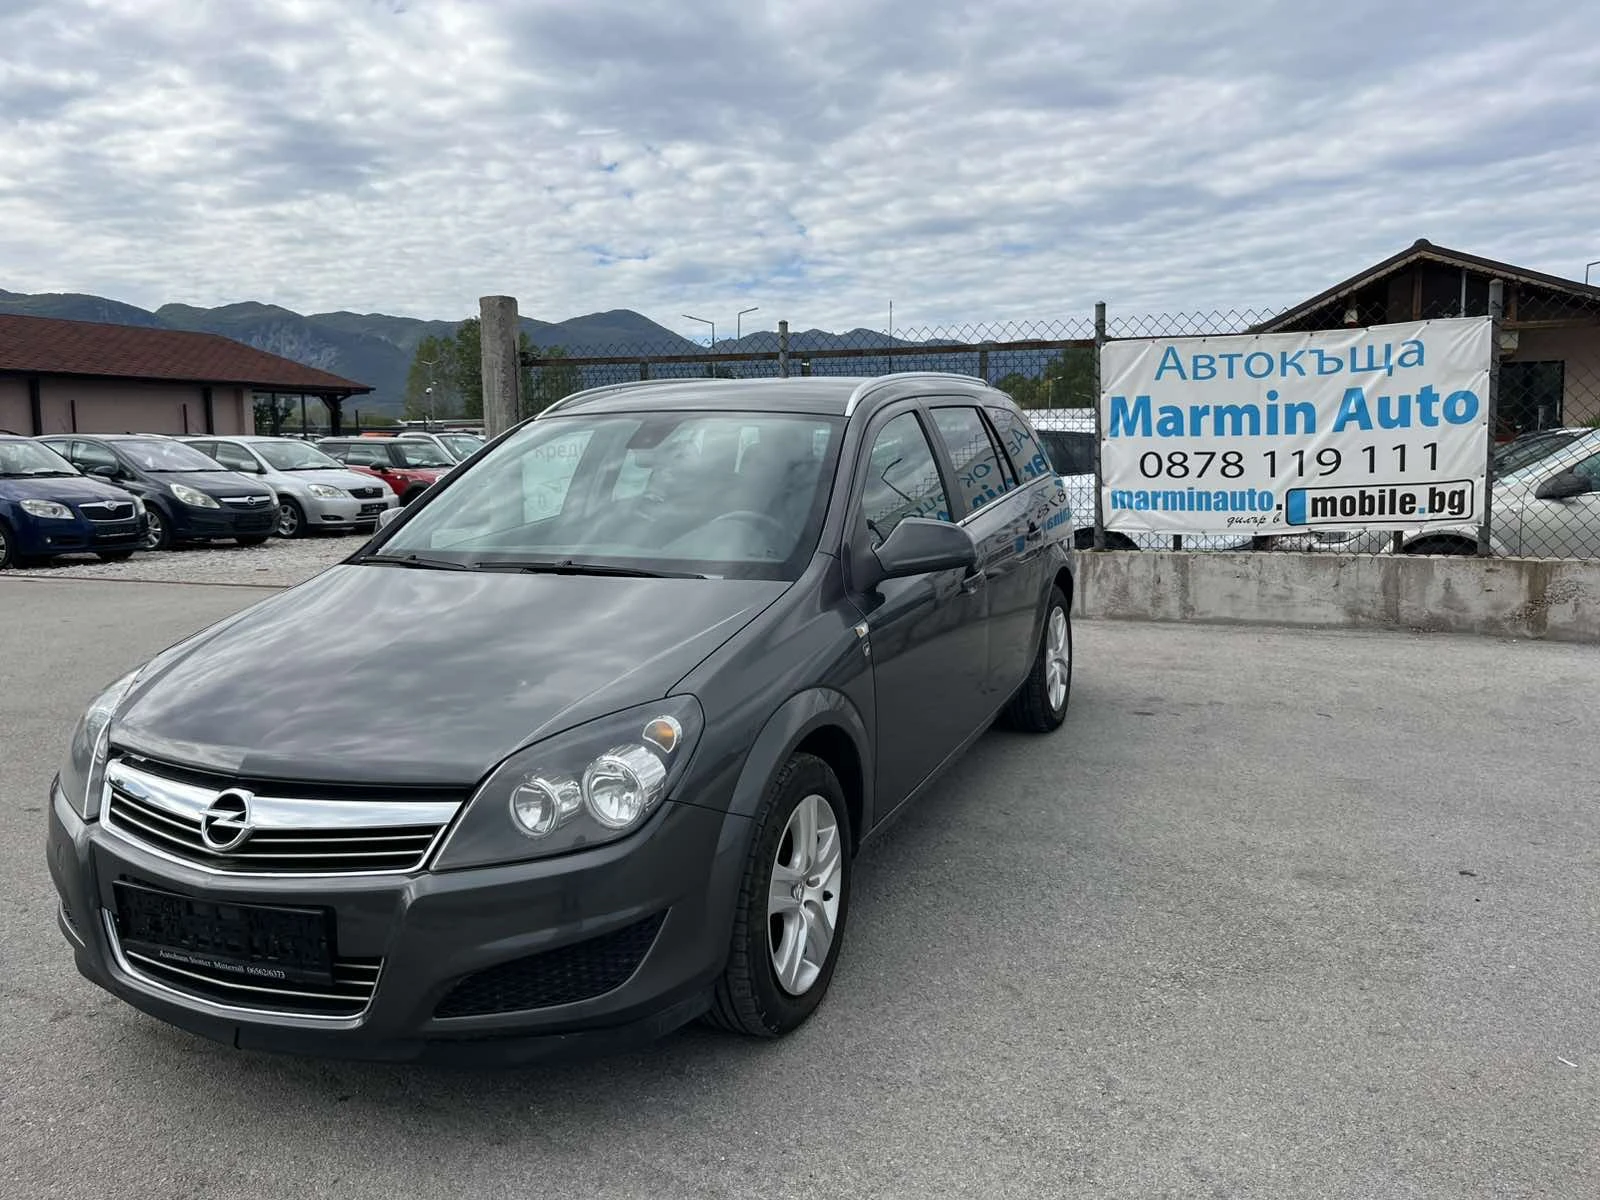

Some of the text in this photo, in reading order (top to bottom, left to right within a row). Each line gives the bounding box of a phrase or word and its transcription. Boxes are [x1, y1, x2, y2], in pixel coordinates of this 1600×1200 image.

[1154, 338, 1426, 382] Автокъща
[1109, 384, 1480, 438] Marmin Auto
[1139, 442, 1438, 479] 0878 119 111
[1311, 486, 1466, 518] mobile.bg
